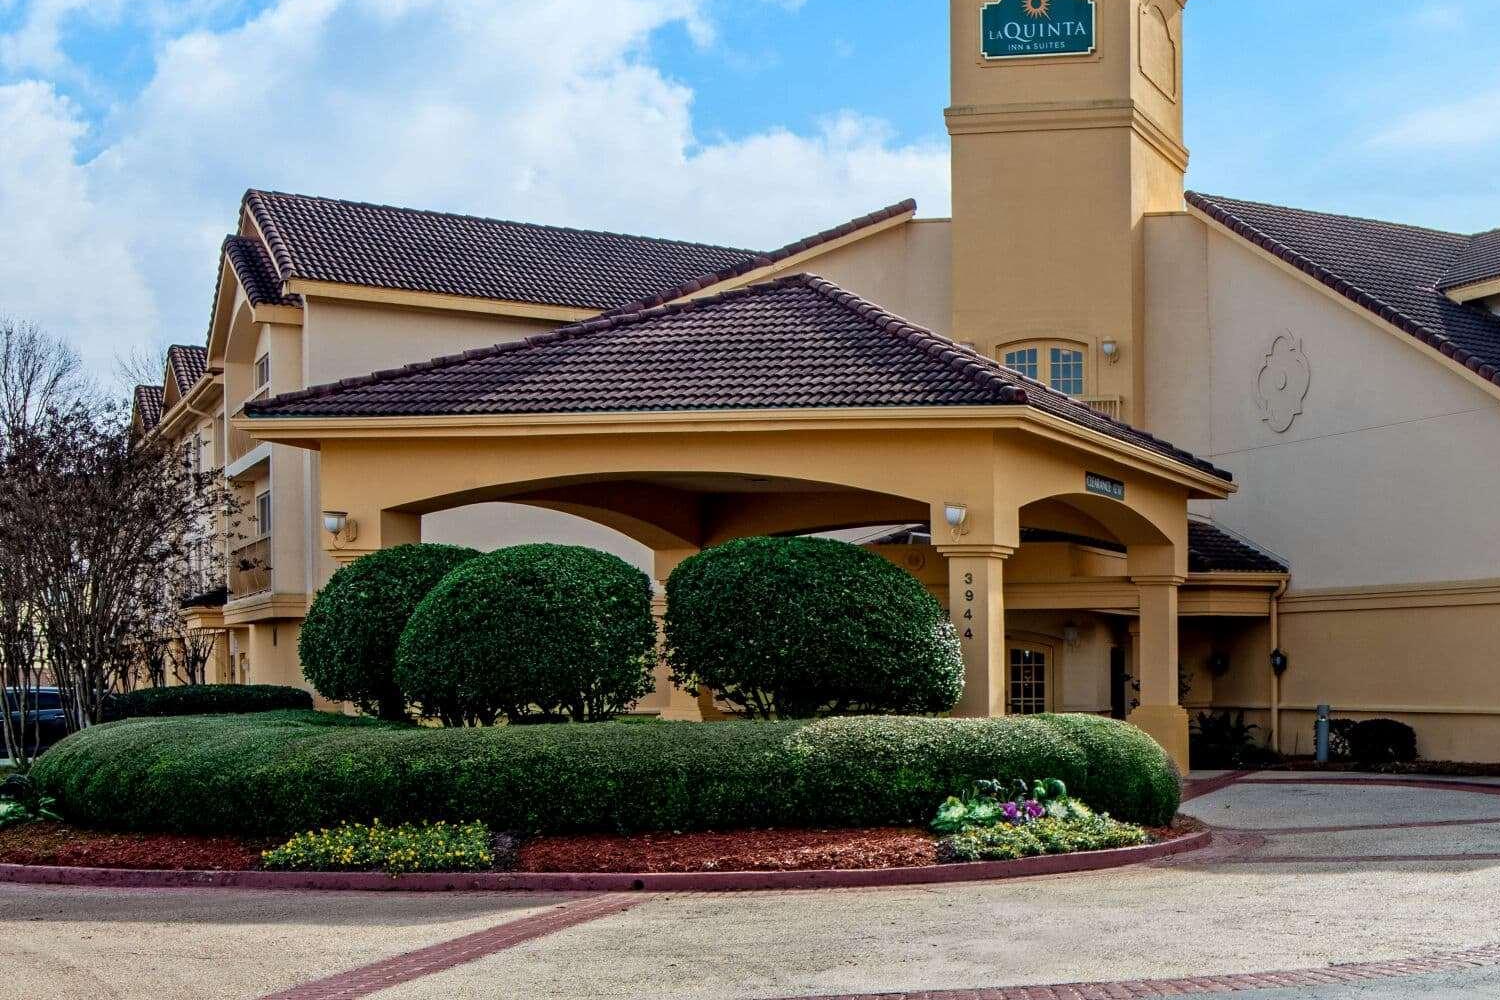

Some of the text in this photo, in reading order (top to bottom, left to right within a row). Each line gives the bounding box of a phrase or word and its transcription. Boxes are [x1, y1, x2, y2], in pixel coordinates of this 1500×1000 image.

[988, 21, 1086, 43] LA QUINTA
[1008, 43, 1024, 51] INN
[1033, 41, 1065, 50] SUITES
[964, 572, 974, 640] 3944
